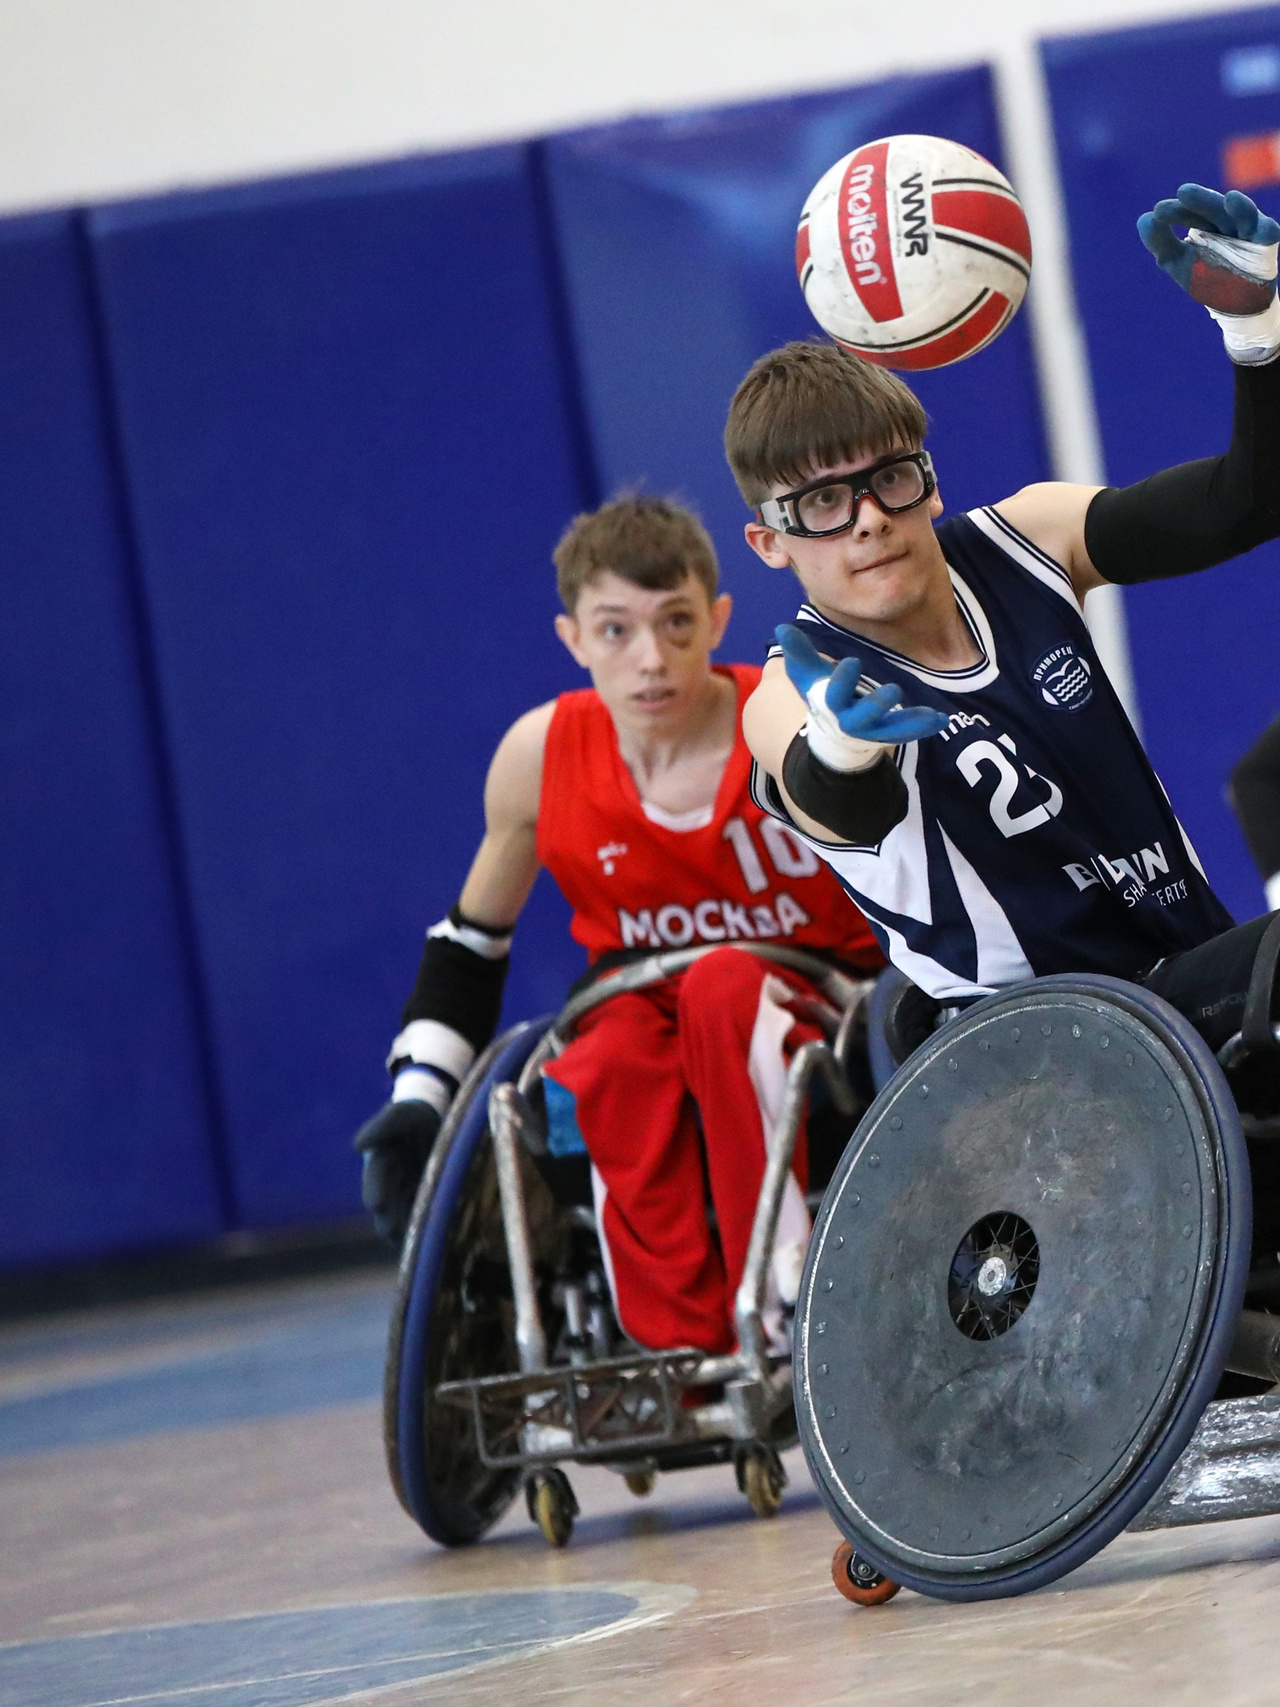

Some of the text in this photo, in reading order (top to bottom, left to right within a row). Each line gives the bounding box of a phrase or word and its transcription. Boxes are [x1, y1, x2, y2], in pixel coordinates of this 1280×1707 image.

[847, 163, 882, 286] molten
[1033, 646, 1073, 681] ПРИМОРЕЦ
[722, 815, 820, 895] 10
[617, 892, 811, 949] МОСКВА
